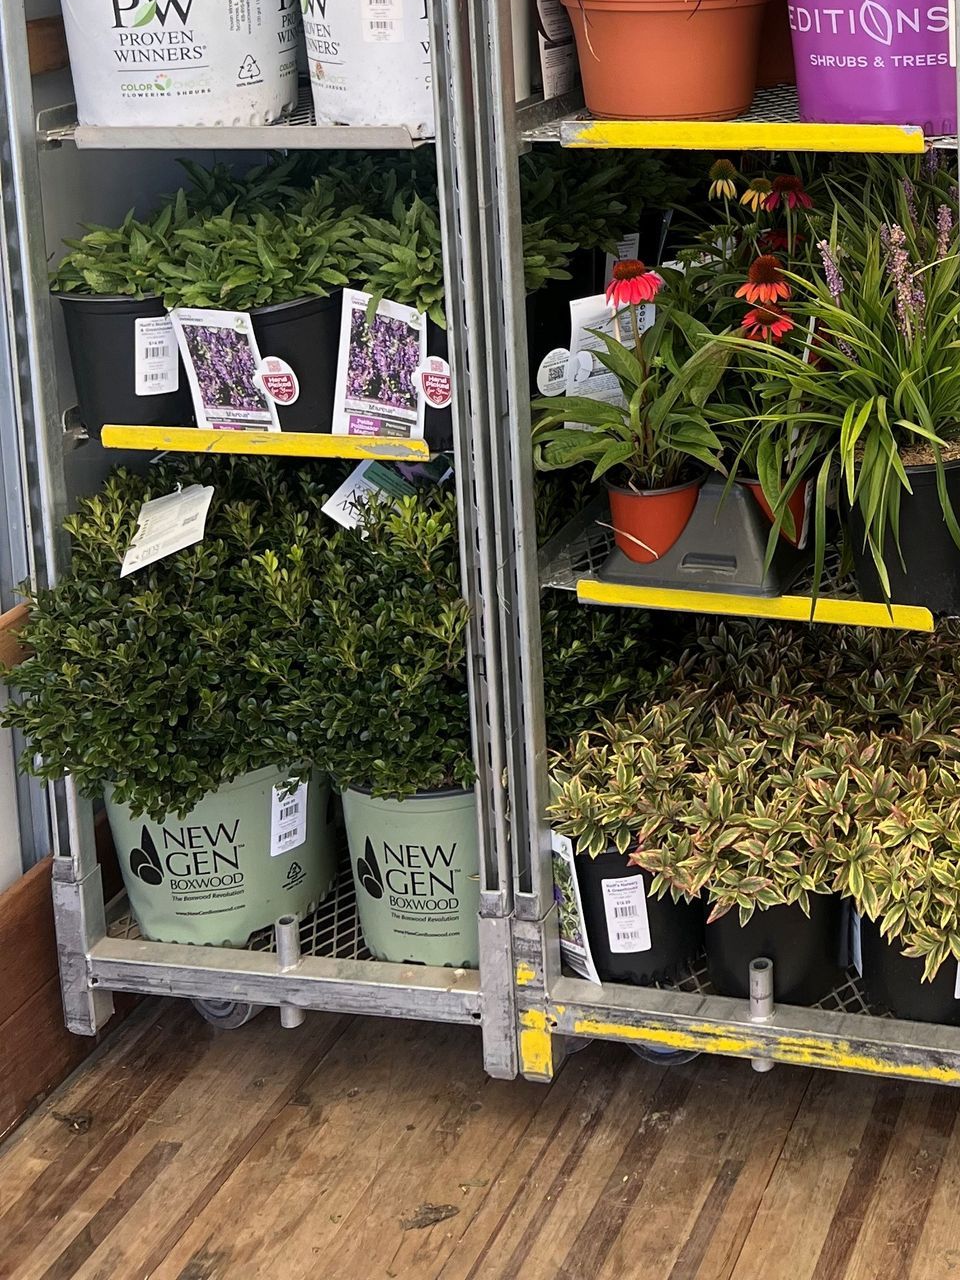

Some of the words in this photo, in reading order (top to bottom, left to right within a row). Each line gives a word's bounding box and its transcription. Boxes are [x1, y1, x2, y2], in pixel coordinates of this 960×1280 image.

[788, 6, 949, 45] EDITIONS
[119, 30, 195, 47] PROVEN
[114, 45, 204, 63] WINNERS
[810, 54, 868, 68] SHRUBS
[873, 55, 885, 68] &
[891, 53, 948, 68] TREES
[121, 83, 153, 92] COLOR
[177, 88, 212, 96] SHRUBS
[267, 381, 292, 389] Picked
[268, 376, 288, 384] Hand
[425, 381, 450, 390] Picked
[428, 376, 447, 384] Hand
[162, 818, 241, 850] NEW
[165, 845, 240, 877] GEN
[383, 840, 457, 868] NEW
[170, 872, 245, 891] BOXWOOD
[385, 869, 455, 896] GEN
[183, 893, 211, 902] Boxwood
[212, 889, 245, 900] Revolution
[389, 895, 459, 911] BOXWOOD
[401, 914, 427, 922] Boxwood
